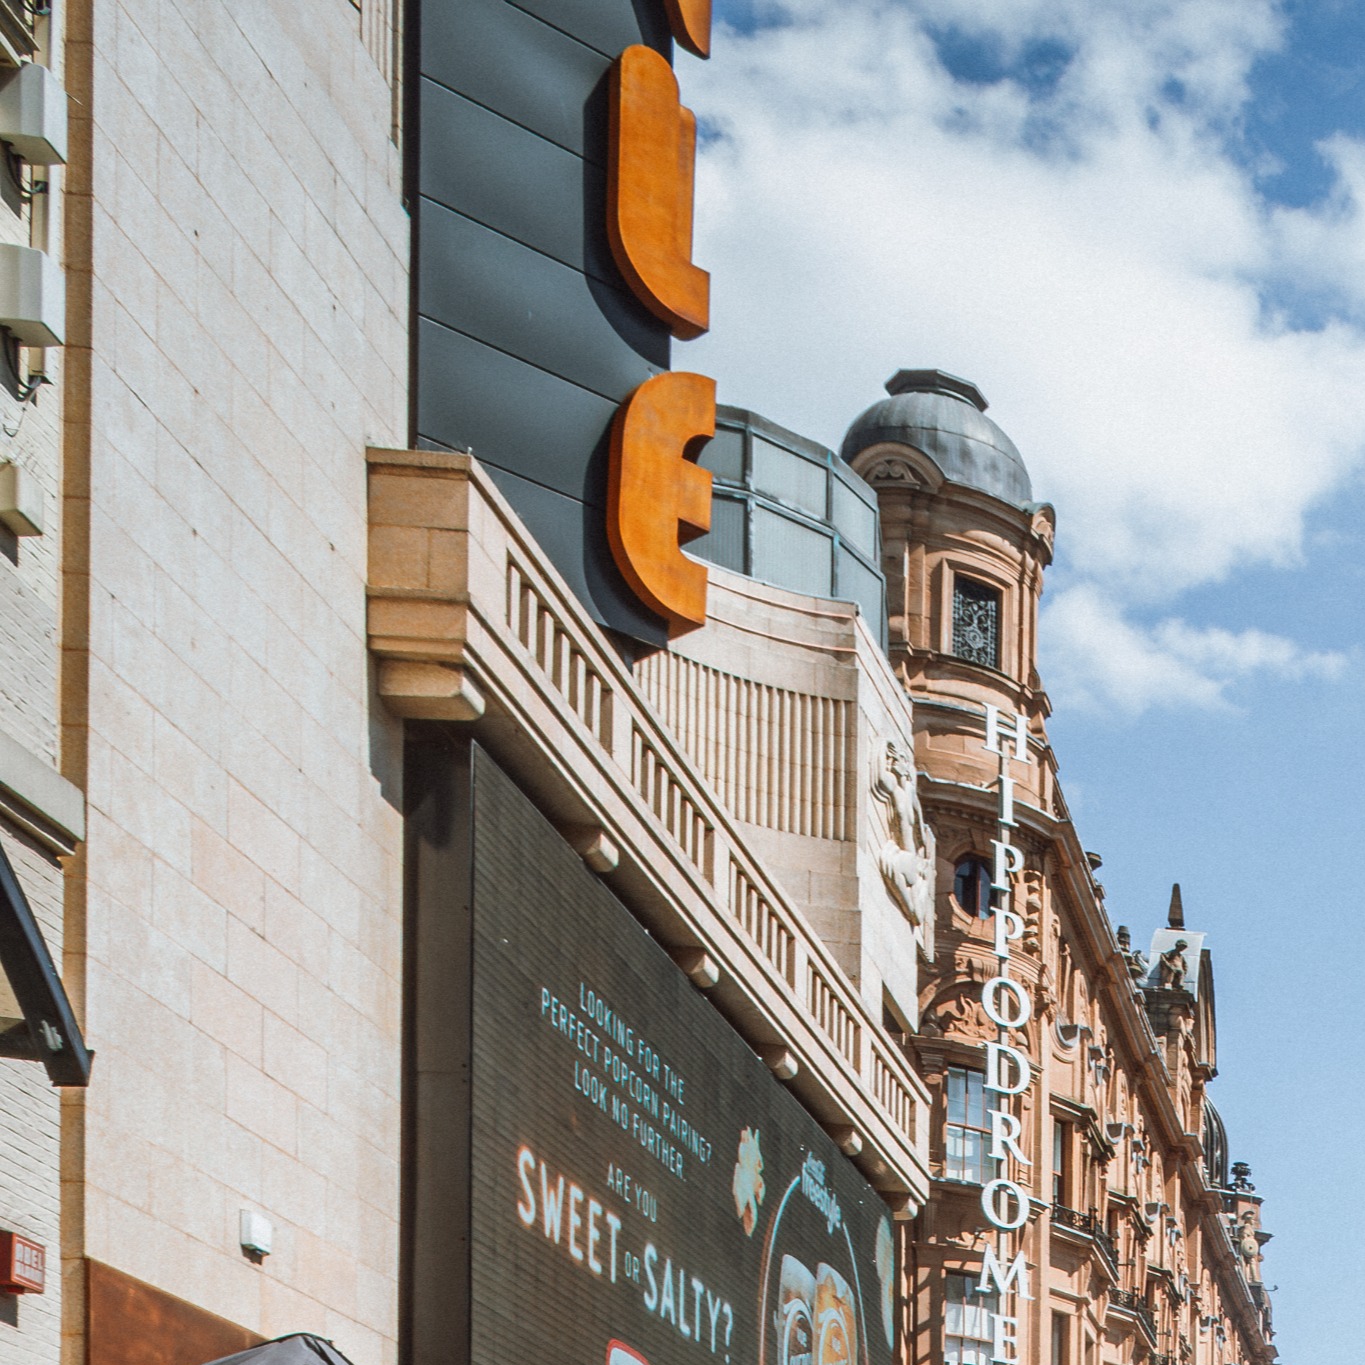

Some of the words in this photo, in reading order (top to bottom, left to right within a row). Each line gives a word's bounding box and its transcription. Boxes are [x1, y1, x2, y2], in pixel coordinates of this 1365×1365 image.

[541, 987, 600, 1058] PERFECT
[604, 1047, 659, 1119] POPCORN
[663, 1102, 712, 1166] PAIRING?
[580, 982, 634, 1056] LOOKING
[638, 1039, 660, 1074] FOR
[664, 1065, 684, 1105] THE
[977, 702, 1035, 1365] HIPPODROME
[574, 1061, 608, 1112] LOOK
[612, 1095, 628, 1130] NO
[633, 1113, 687, 1182] FURTHER.
[607, 1162, 631, 1203] ARE
[634, 1183, 657, 1223] YOU
[516, 1144, 621, 1283] SWEET
[624, 1251, 640, 1283] OR
[643, 1242, 733, 1364] SALTY?
